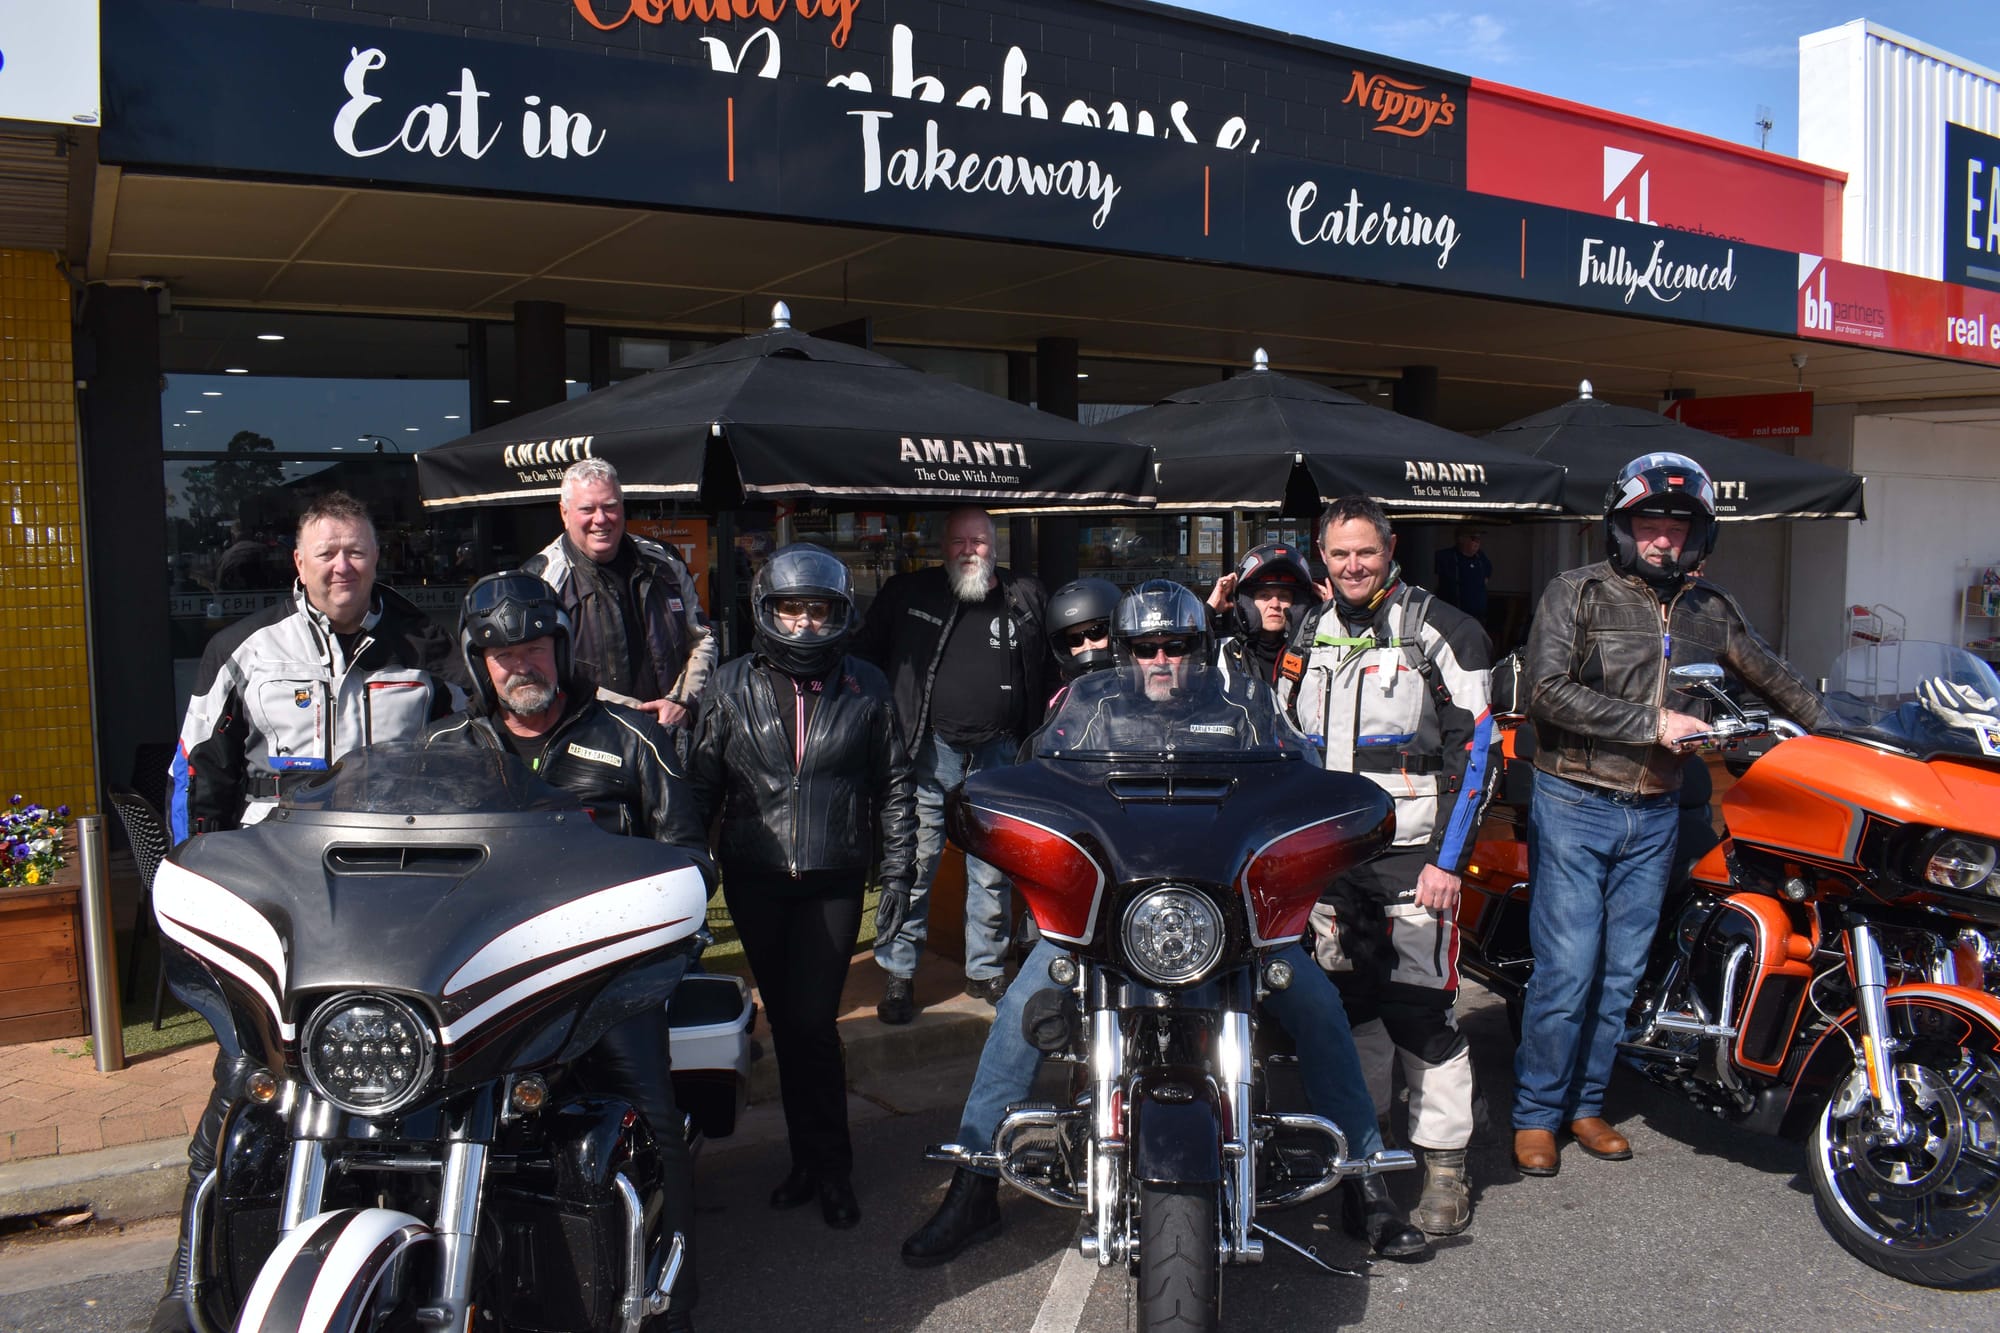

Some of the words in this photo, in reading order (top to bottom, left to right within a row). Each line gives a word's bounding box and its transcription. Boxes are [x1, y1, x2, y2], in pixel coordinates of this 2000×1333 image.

[333, 46, 502, 159] Eat
[522, 95, 606, 159] in
[1342, 70, 1456, 137] Nippy's
[847, 111, 1121, 229] Takeaway
[1287, 181, 1461, 269] Catering
[1804, 266, 1832, 331] bh
[1834, 301, 1884, 325] partners
[1947, 314, 1985, 348] real
[1752, 425, 1770, 436] real
[1771, 425, 1800, 435] estate
[504, 435, 594, 468] AMANTI
[900, 437, 1028, 468] AMANTI
[518, 471, 533, 484] The
[532, 471, 548, 482] One
[914, 467, 936, 482] The
[938, 468, 961, 482] One
[961, 470, 987, 483] With
[990, 472, 1020, 484] Aroma
[1404, 461, 1486, 483] AMANTI
[1412, 485, 1426, 496] The
[1426, 486, 1440, 496] One
[1442, 486, 1458, 497] With
[1459, 488, 1480, 497] Aroma
